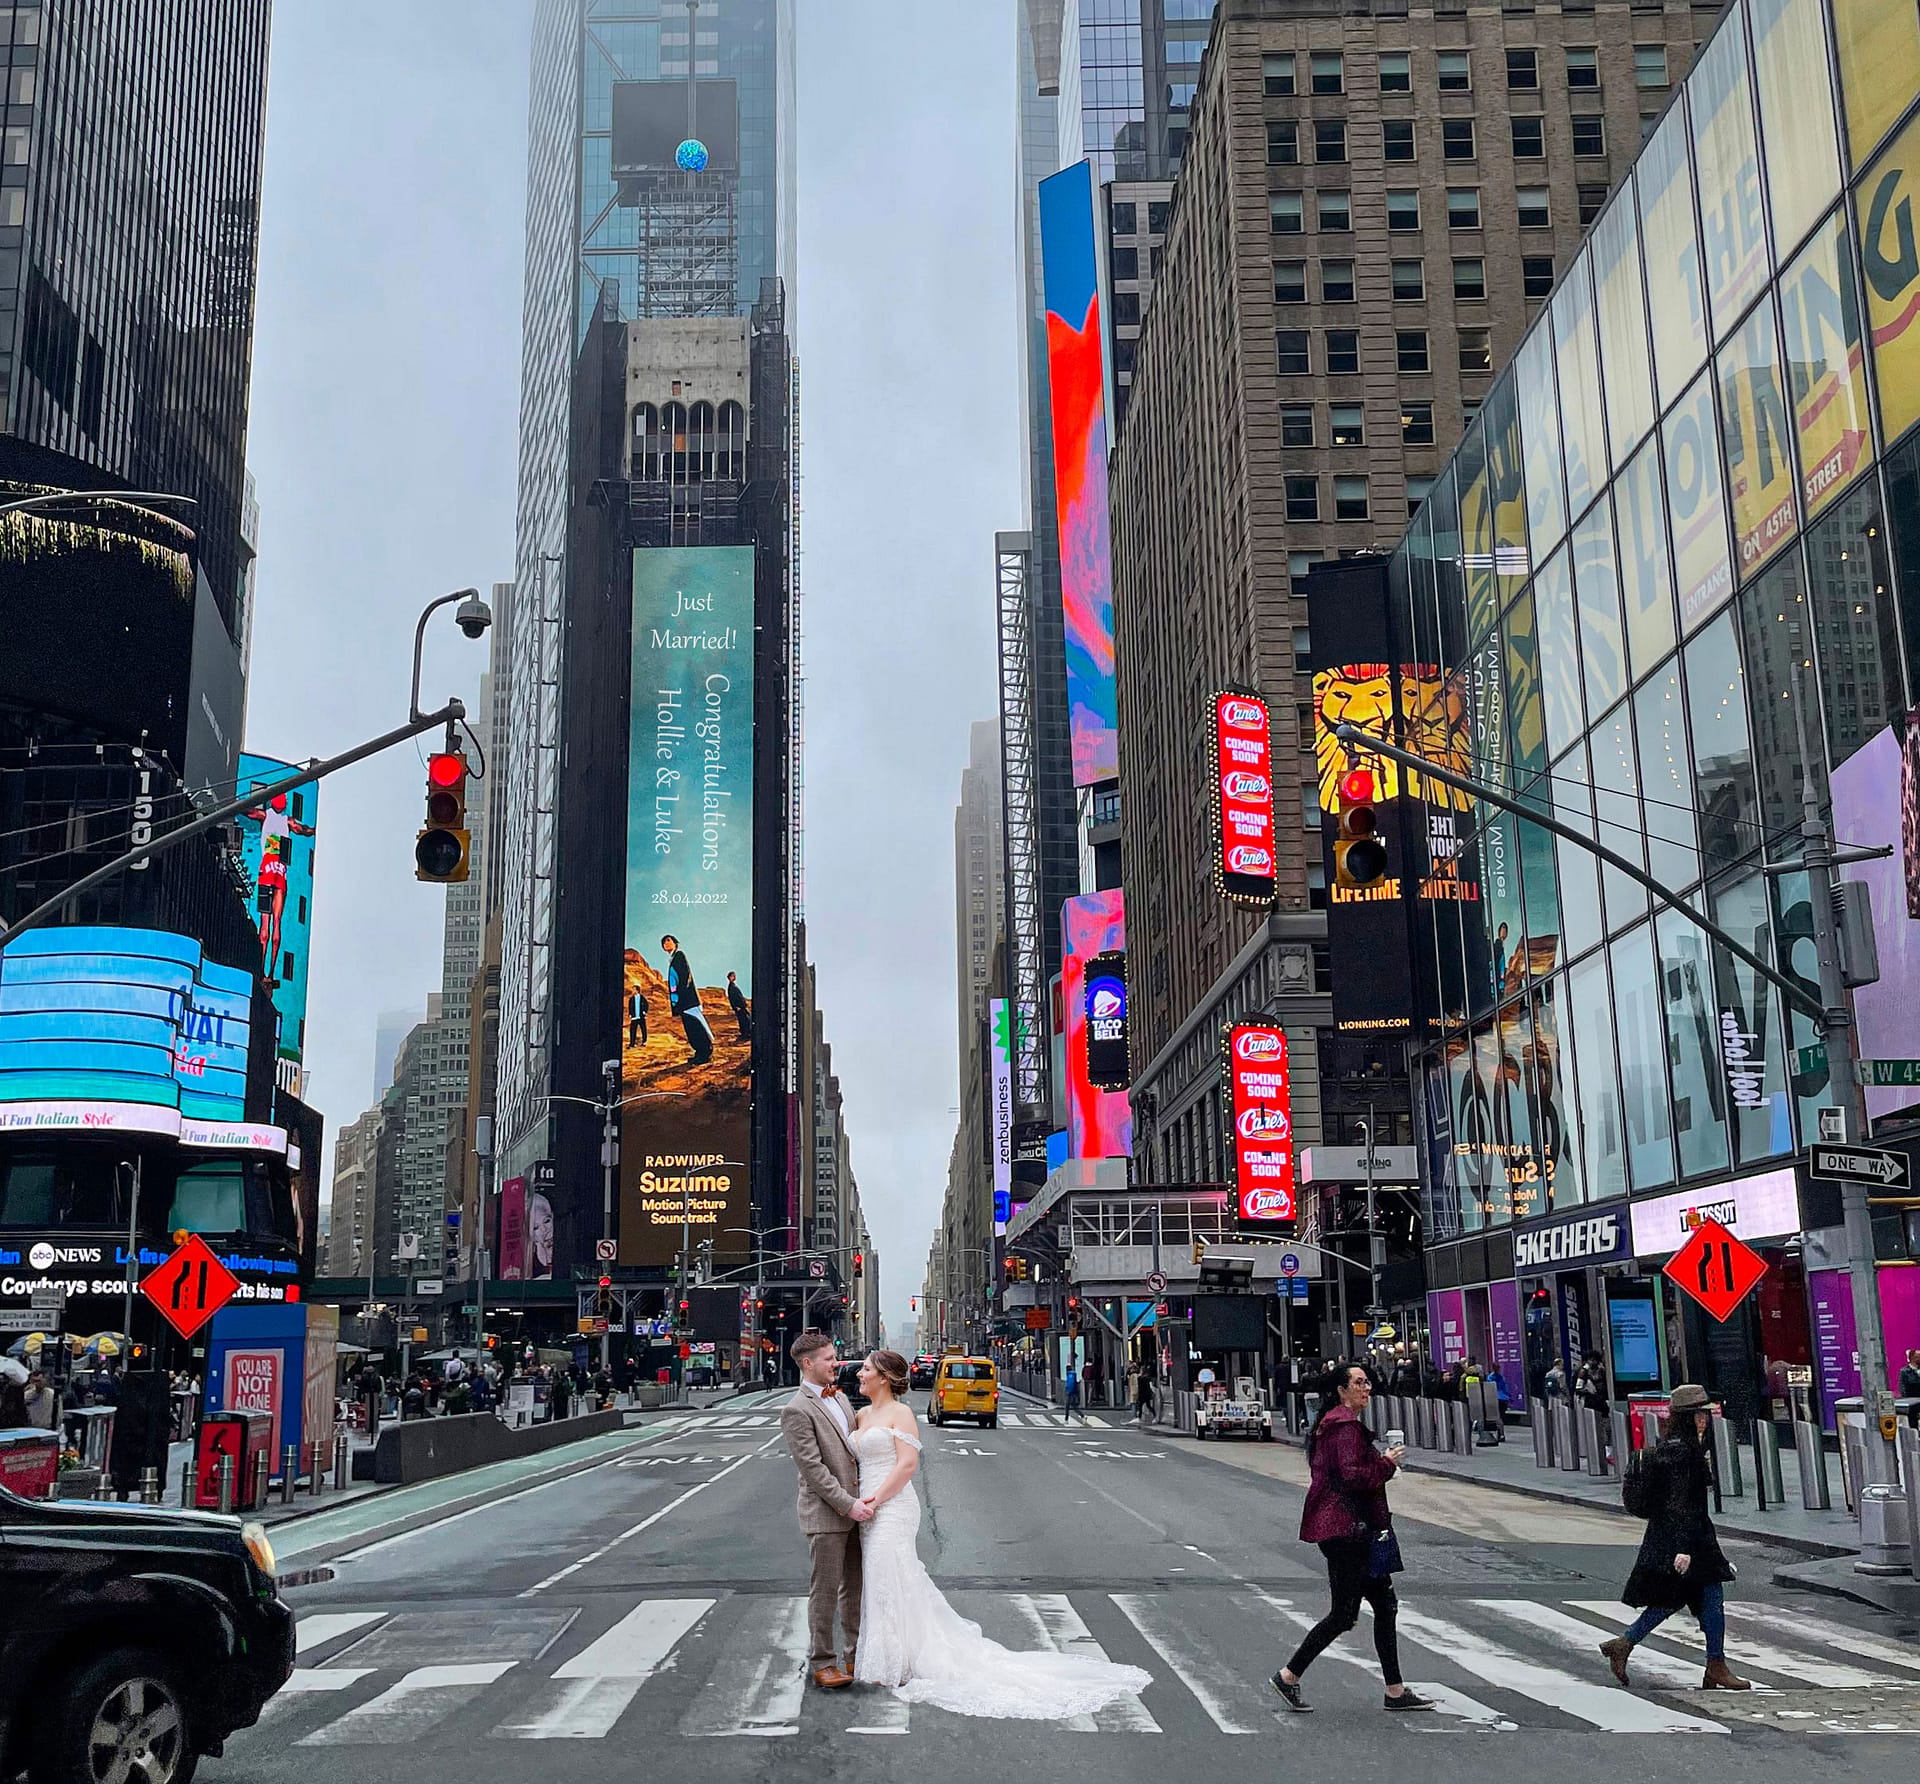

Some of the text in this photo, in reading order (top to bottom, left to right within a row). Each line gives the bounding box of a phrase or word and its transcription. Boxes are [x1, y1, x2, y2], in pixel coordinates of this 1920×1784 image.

[1679, 153, 1766, 326] THE
[1622, 169, 1919, 613] LION KING
[1743, 533, 1762, 561] ON
[1766, 501, 1793, 538] 45TH
[1806, 451, 1843, 502] STREET
[671, 591, 714, 617] Just
[651, 627, 737, 650] Married!
[1225, 737, 1264, 754] COMING
[1232, 749, 1259, 764] SOON
[655, 688, 685, 855] Hollie & Luke
[695, 673, 732, 871] Congratulations
[1228, 810, 1268, 827] COMING
[1235, 823, 1262, 837] SOON
[651, 890, 728, 908] 28.04.2022
[1092, 1019, 1122, 1031] TACO
[1338, 1017, 1411, 1031] LIONKING.COM
[1094, 1029, 1123, 1041] BELL
[1237, 1033, 1281, 1057] Cane's
[1807, 1049, 1815, 1068] 7
[1240, 1072, 1283, 1086] COMING
[1877, 1063, 1893, 1082] W
[1247, 1085, 1277, 1099] SOON
[10, 1114, 32, 1126] Fun
[35, 1112, 79, 1125] Italian
[82, 1112, 114, 1129] Style
[1000, 1076, 1010, 1165] zenbusiness
[188, 1131, 208, 1143] Fun
[209, 1132, 249, 1144] Italian
[645, 1154, 725, 1168] RADWIMPS
[1243, 1151, 1287, 1166] COMING
[1827, 1154, 1896, 1177] ONE WAY
[1251, 1164, 1281, 1177] SOON
[639, 1171, 731, 1194] Suzume
[642, 1198, 727, 1212] Motion Picture
[1245, 1189, 1290, 1213] Cane's
[1515, 1213, 1617, 1268] SKECHERS
[32, 1251, 53, 1260] abc
[55, 1248, 102, 1263] NEWS
[236, 1359, 273, 1377] YOU ARE
[237, 1376, 273, 1395] NOT
[235, 1394, 271, 1410] ALONE
[617, 1453, 737, 1467] ONLY
